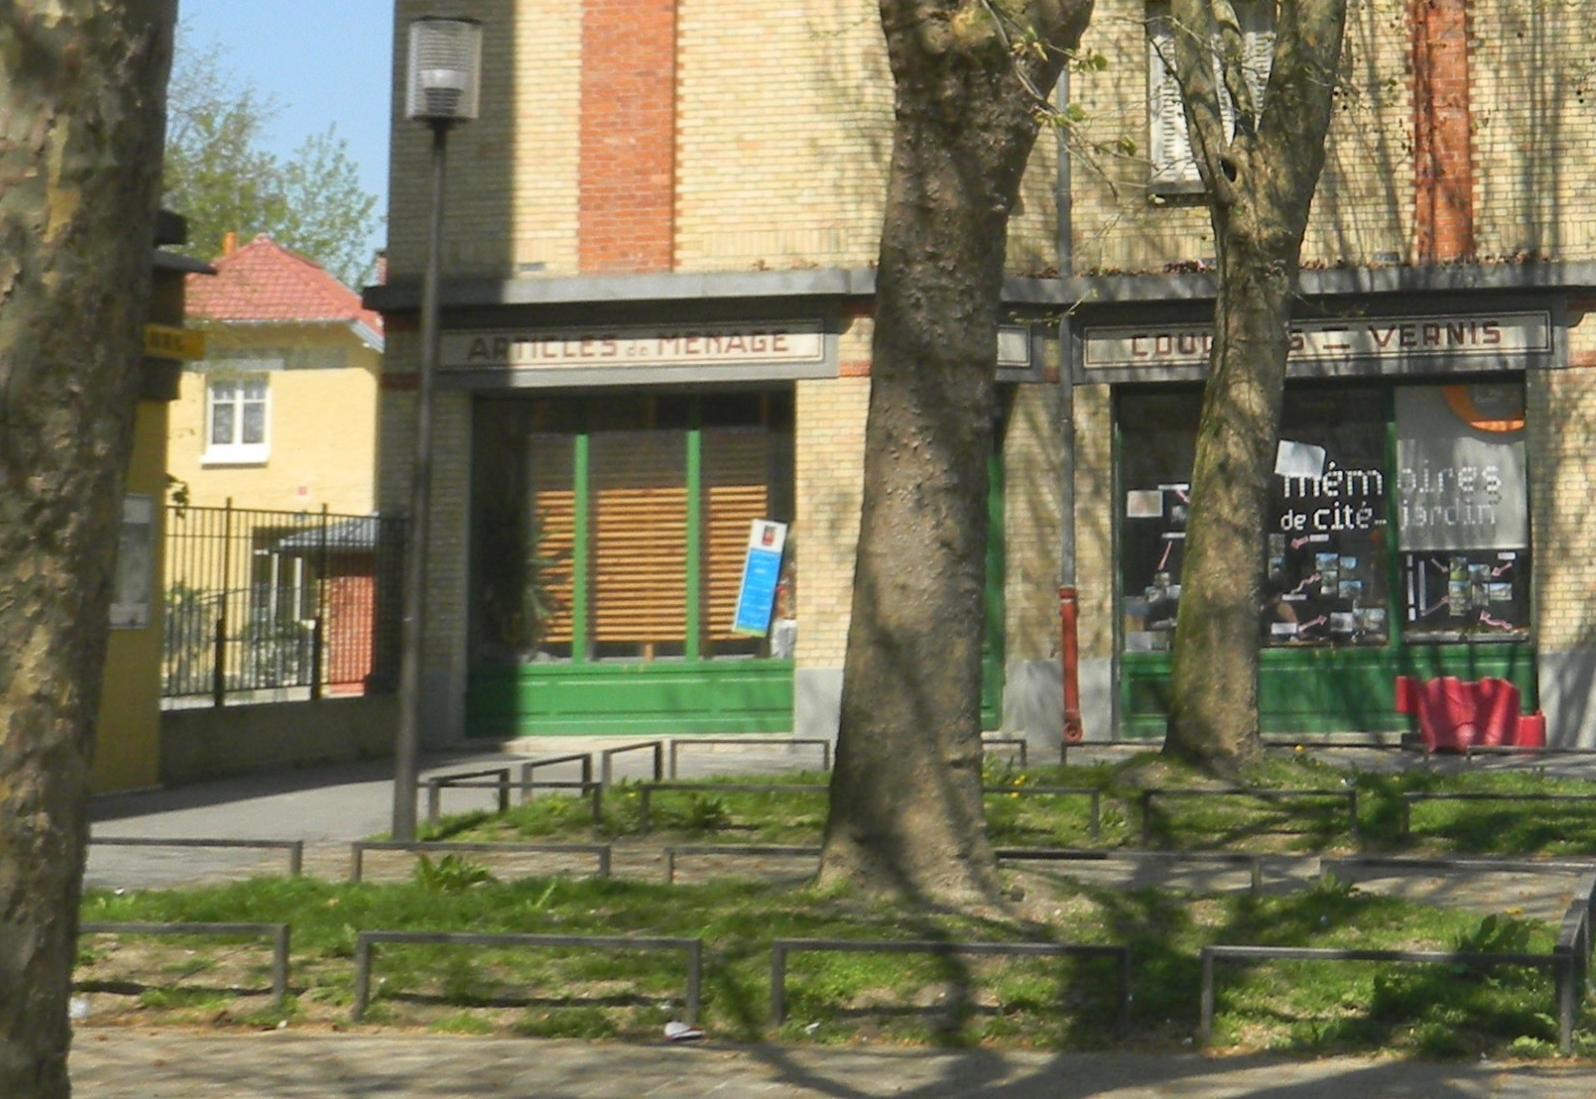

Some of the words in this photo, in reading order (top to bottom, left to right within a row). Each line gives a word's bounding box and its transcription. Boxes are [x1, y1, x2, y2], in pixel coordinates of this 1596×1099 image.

[466, 333, 618, 360] ARTICLES
[626, 340, 649, 357] de
[657, 329, 790, 356] MENAGE
[1368, 321, 1502, 348] VERNIS
[1280, 509, 1307, 531] de
